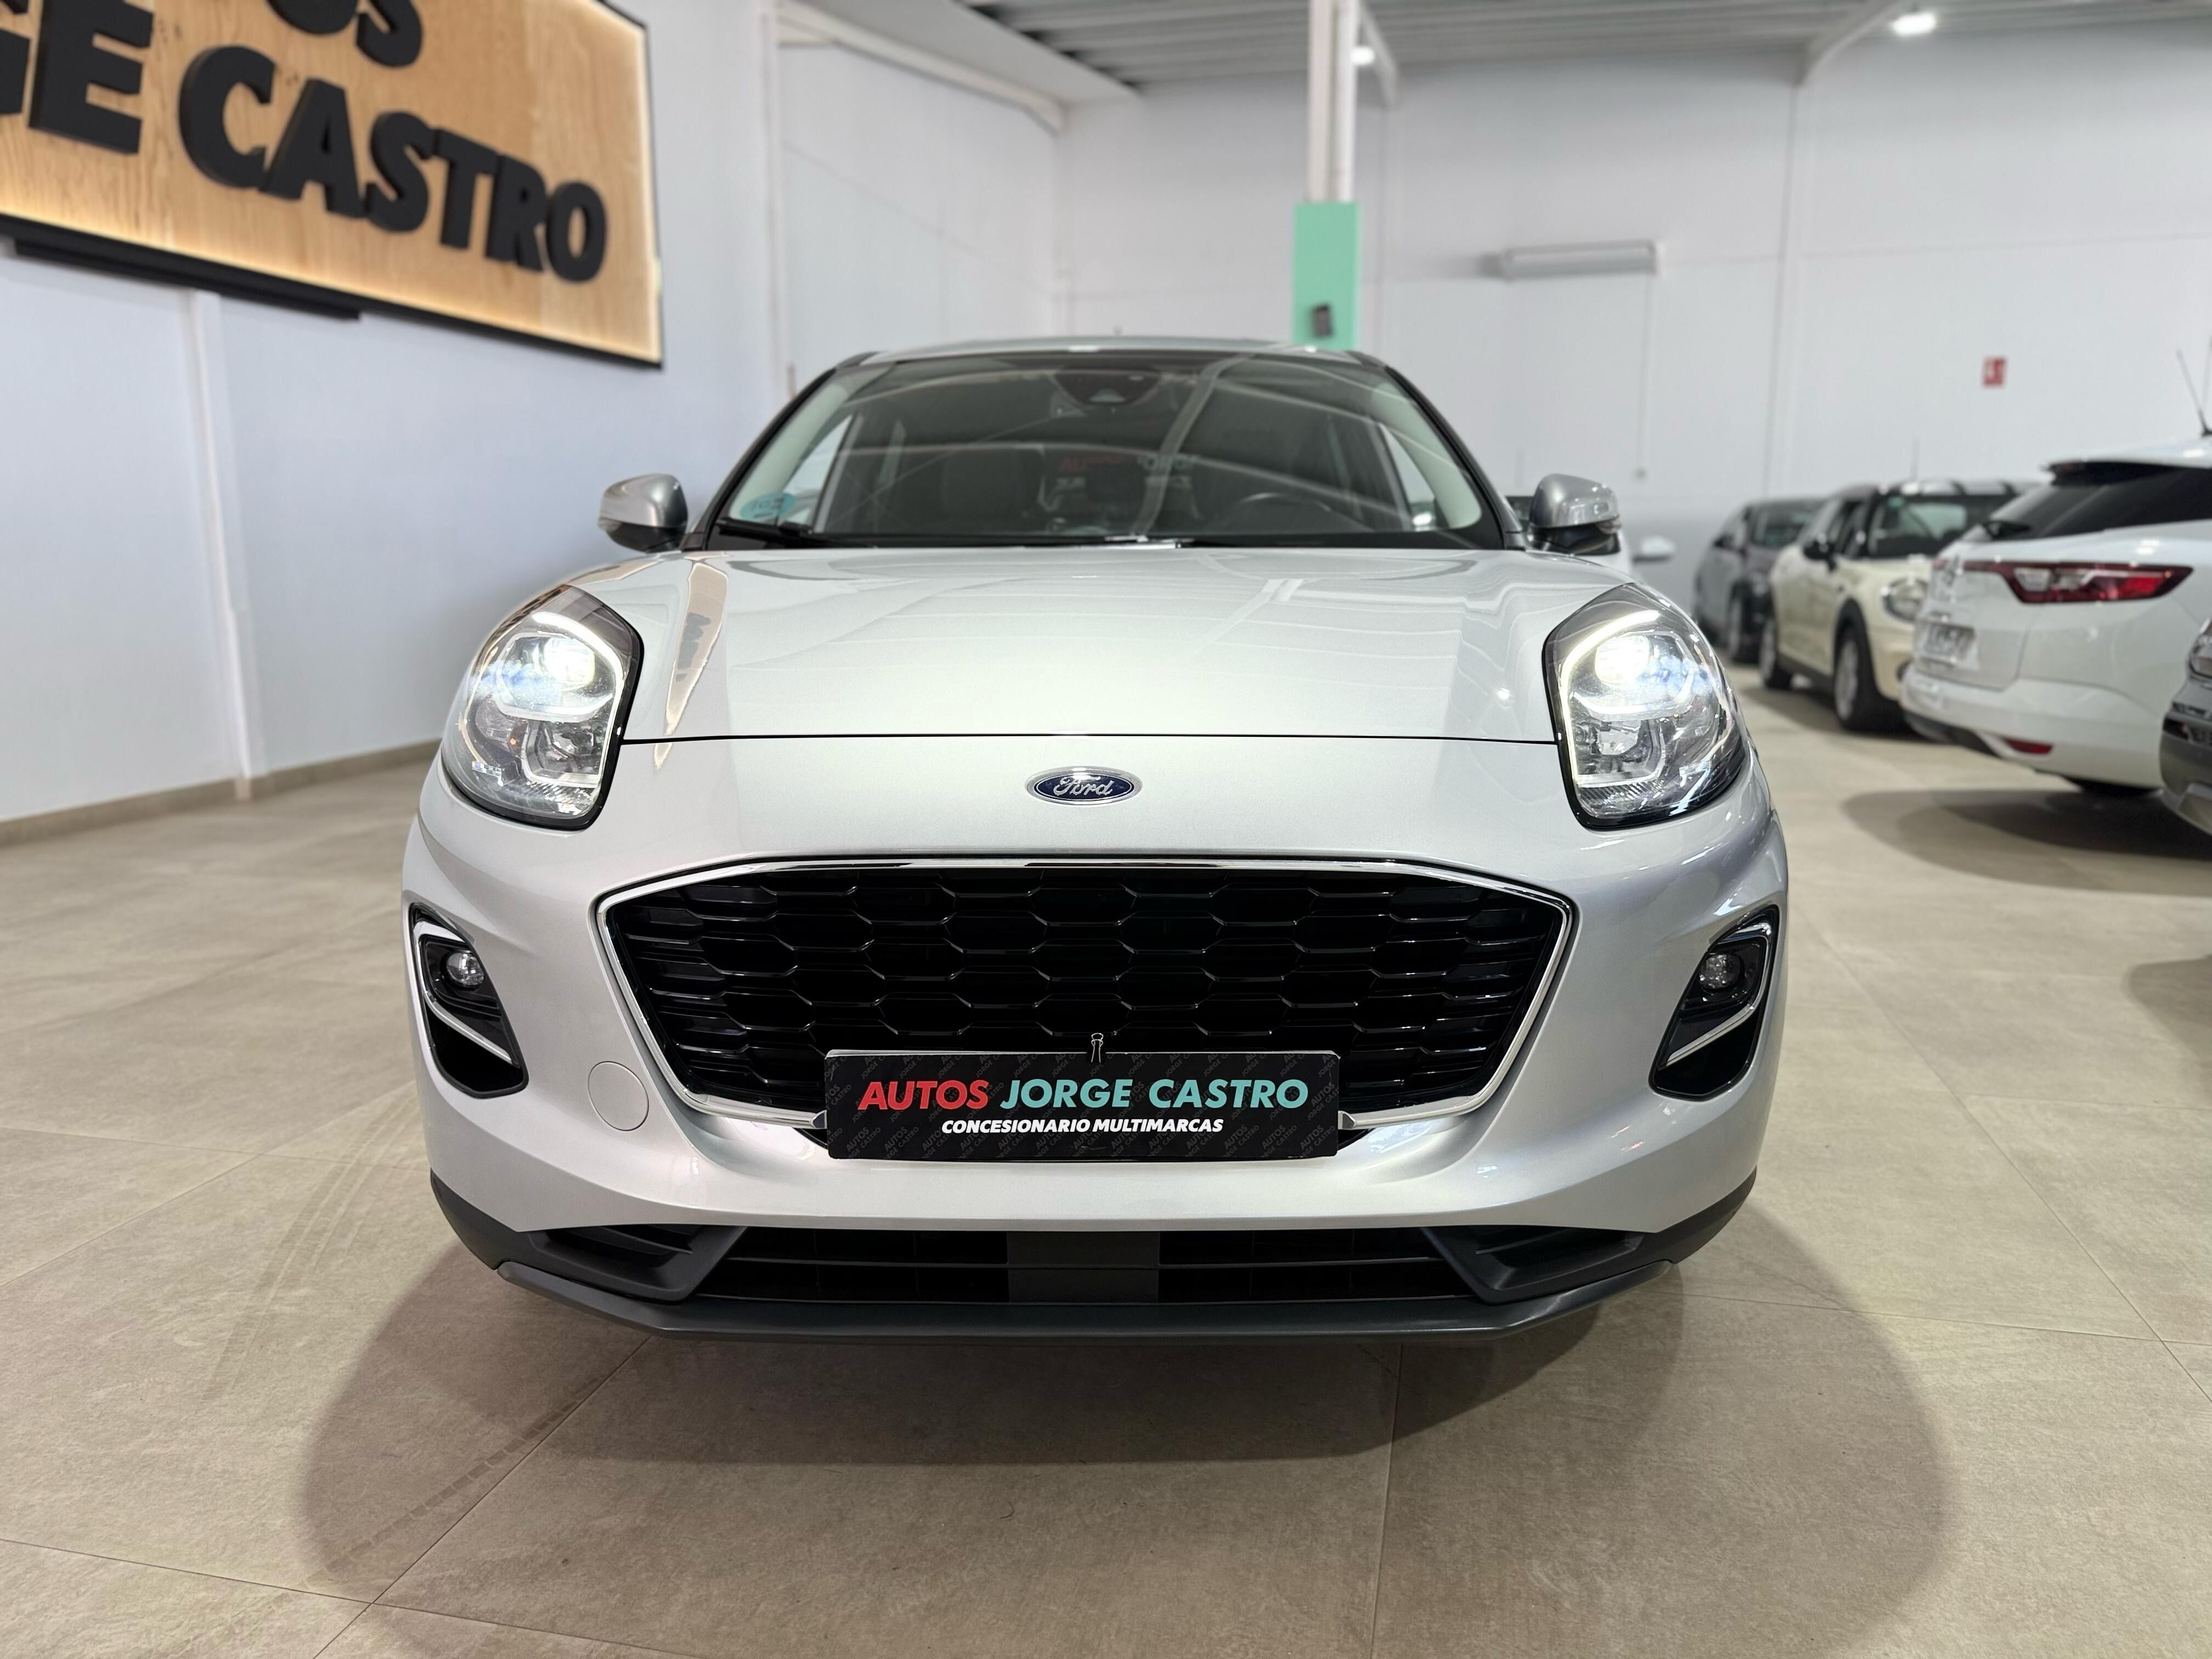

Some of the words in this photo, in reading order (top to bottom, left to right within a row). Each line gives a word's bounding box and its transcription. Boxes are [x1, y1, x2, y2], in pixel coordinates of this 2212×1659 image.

[181, 45, 607, 283] CASTRO
[1053, 774, 1115, 797] Ford
[861, 1060, 878, 1080] JORGE
[899, 1060, 917, 1079] JORGE
[938, 1059, 955, 1079] JORGE
[975, 1059, 993, 1078] JORGE
[1013, 1059, 1031, 1077] JORGE
[1052, 1059, 1069, 1077] JORGE
[1127, 1059, 1146, 1077] JORGE
[1165, 1059, 1183, 1077] JORGE
[1204, 1059, 1221, 1077] JORGE
[1242, 1059, 1259, 1077] JORGE
[1279, 1059, 1297, 1077] JORGE
[1318, 1059, 1336, 1077] JORGE
[857, 1079, 989, 1110] AUTOS
[1000, 1078, 1133, 1109] JORGE
[1149, 1079, 1308, 1109] CASTRO
[1269, 1105, 1284, 1120] JORG
[1307, 1103, 1324, 1121] JORGE
[941, 1119, 1091, 1134] CONCESIONARIO
[1092, 1118, 1224, 1133] MULTIMARCAS
[1238, 1125, 1259, 1146] CASTRO
[1276, 1125, 1297, 1146] CASTRO
[1314, 1125, 1335, 1146] CASTRO
[846, 1126, 870, 1152] AUTOS
[860, 1127, 881, 1148] CASTRO
[884, 1126, 908, 1151] AUTOS
[898, 1126, 919, 1147] CASTRO
[1224, 1124, 1248, 1150] AUTOS
[1262, 1124, 1285, 1150] AUTOS
[1300, 1125, 1323, 1150] AUTOS
